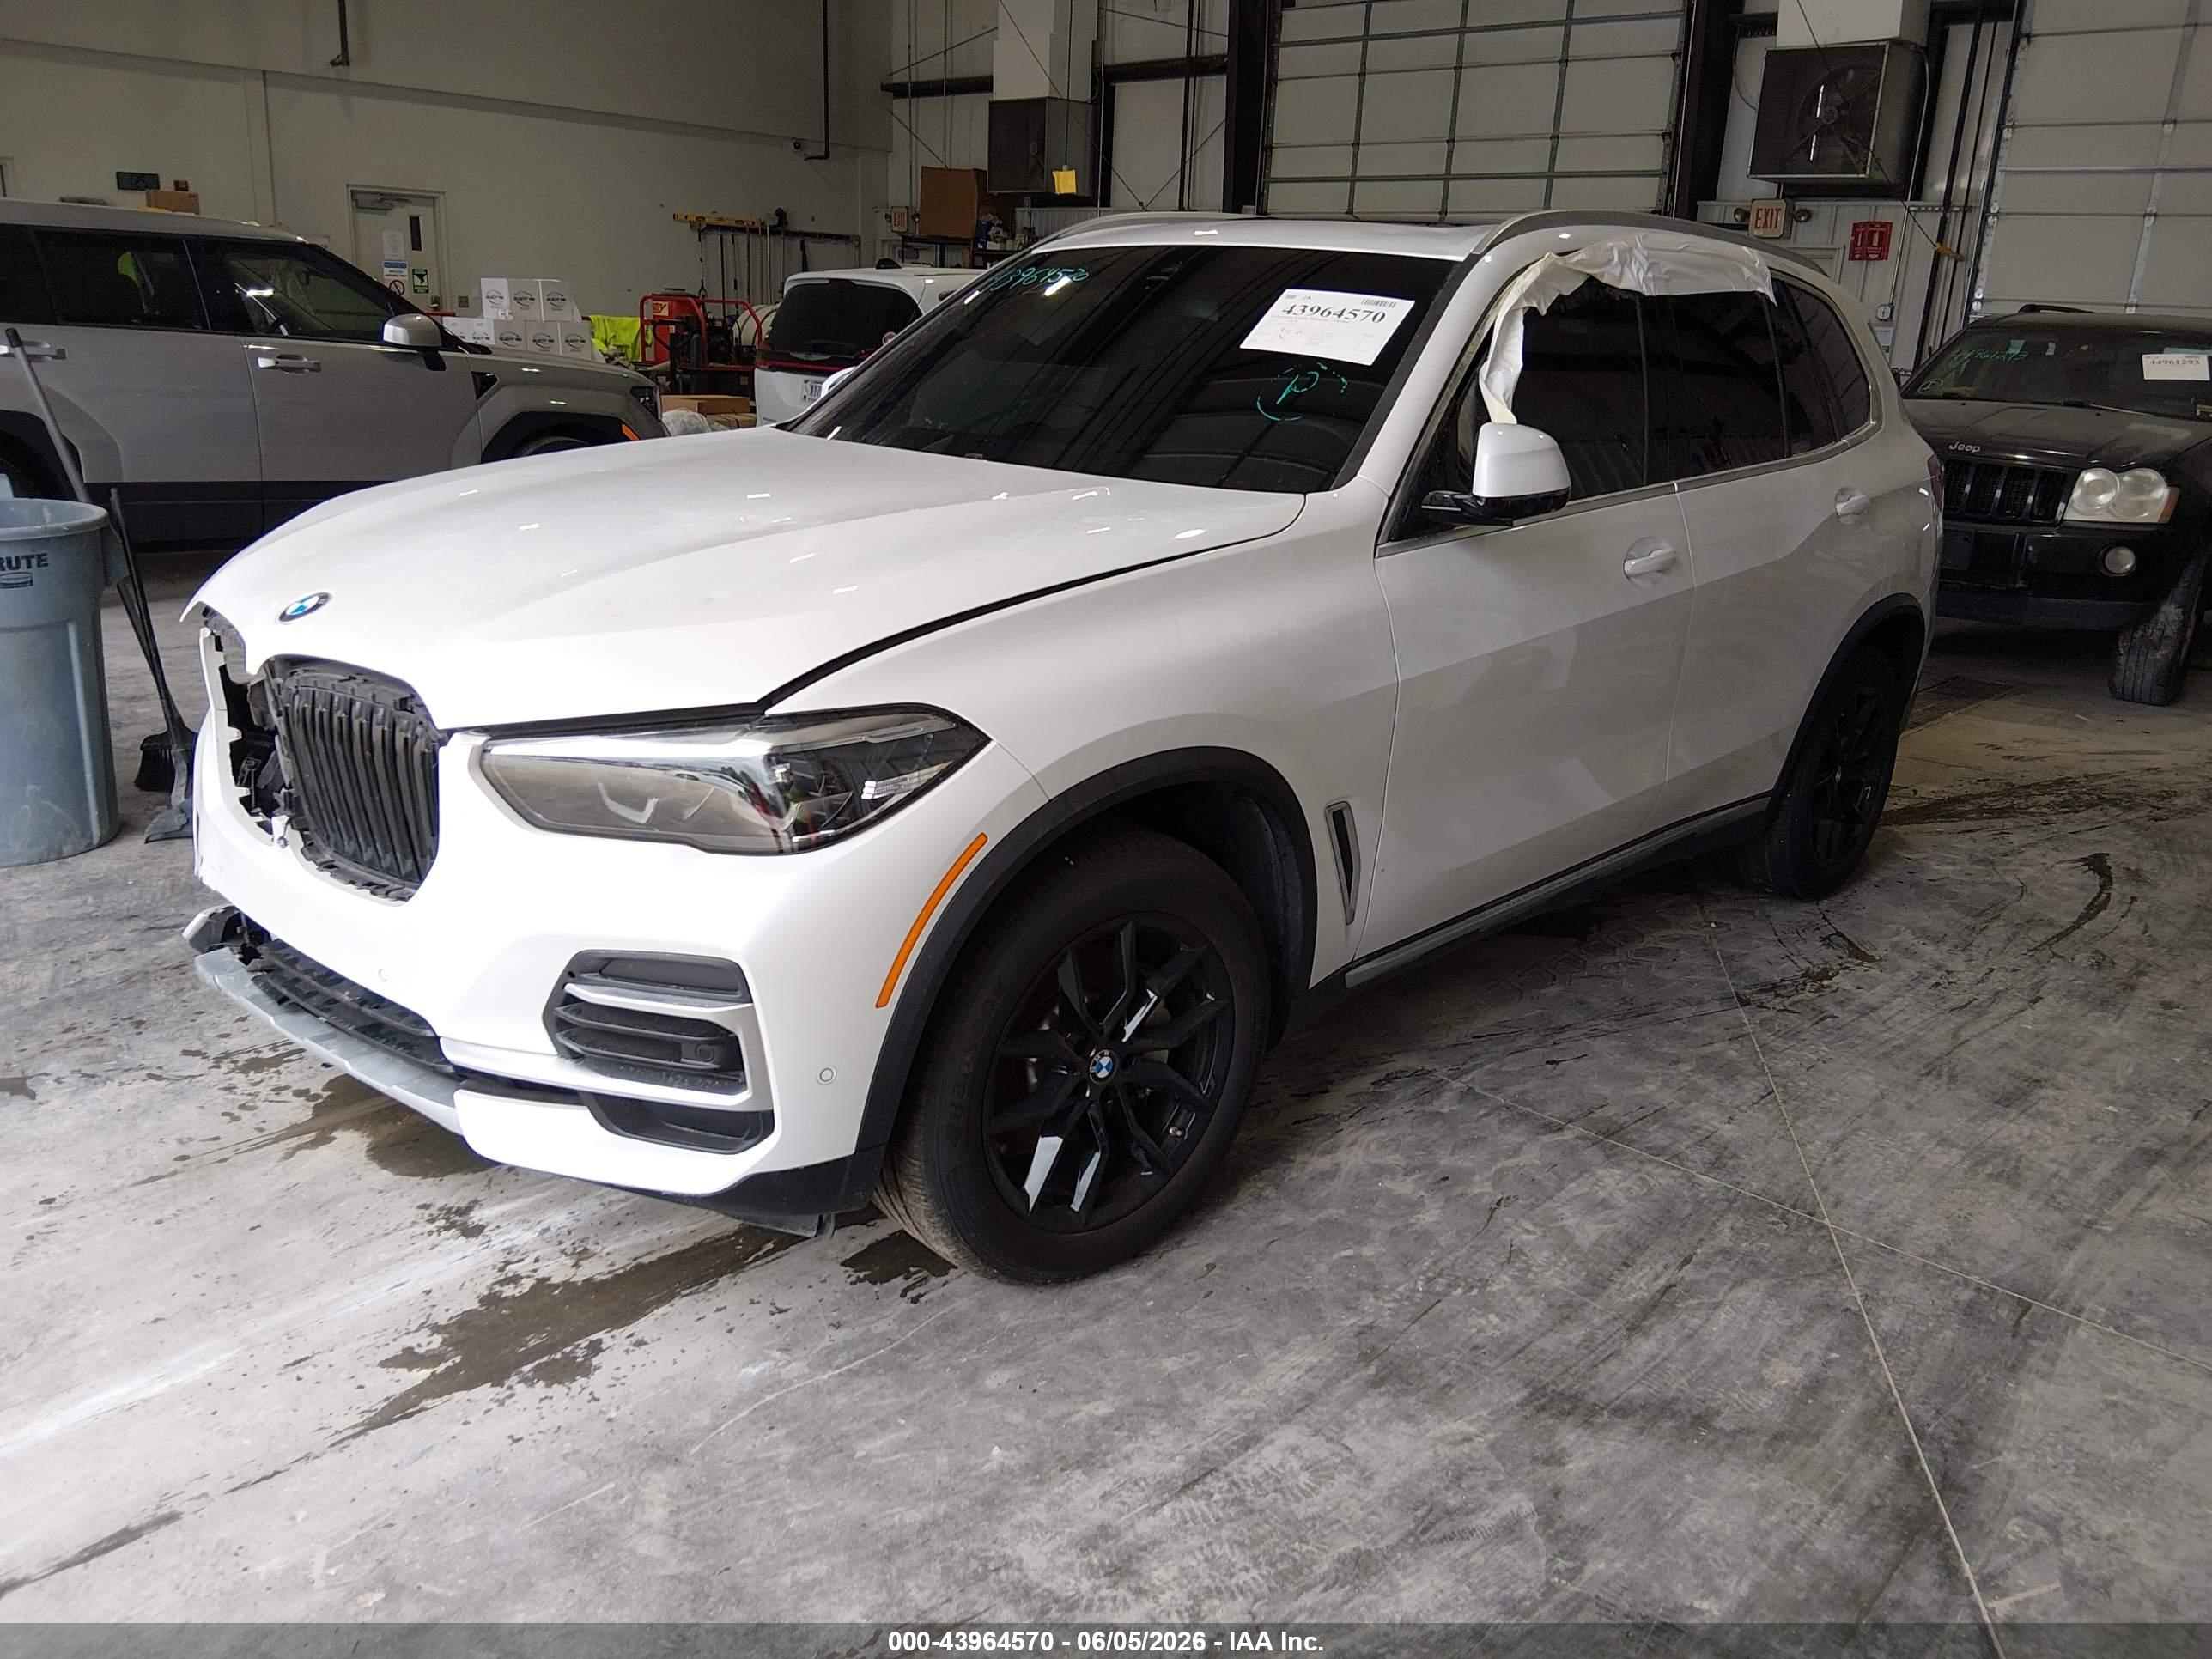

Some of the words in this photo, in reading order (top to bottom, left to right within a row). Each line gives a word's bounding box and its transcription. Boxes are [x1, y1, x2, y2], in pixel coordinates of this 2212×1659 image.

[1754, 208, 1782, 229] EXIT
[1283, 303, 1387, 324] 43964570
[810, 384, 823, 398] A17
[1948, 441, 1981, 453] Jeep
